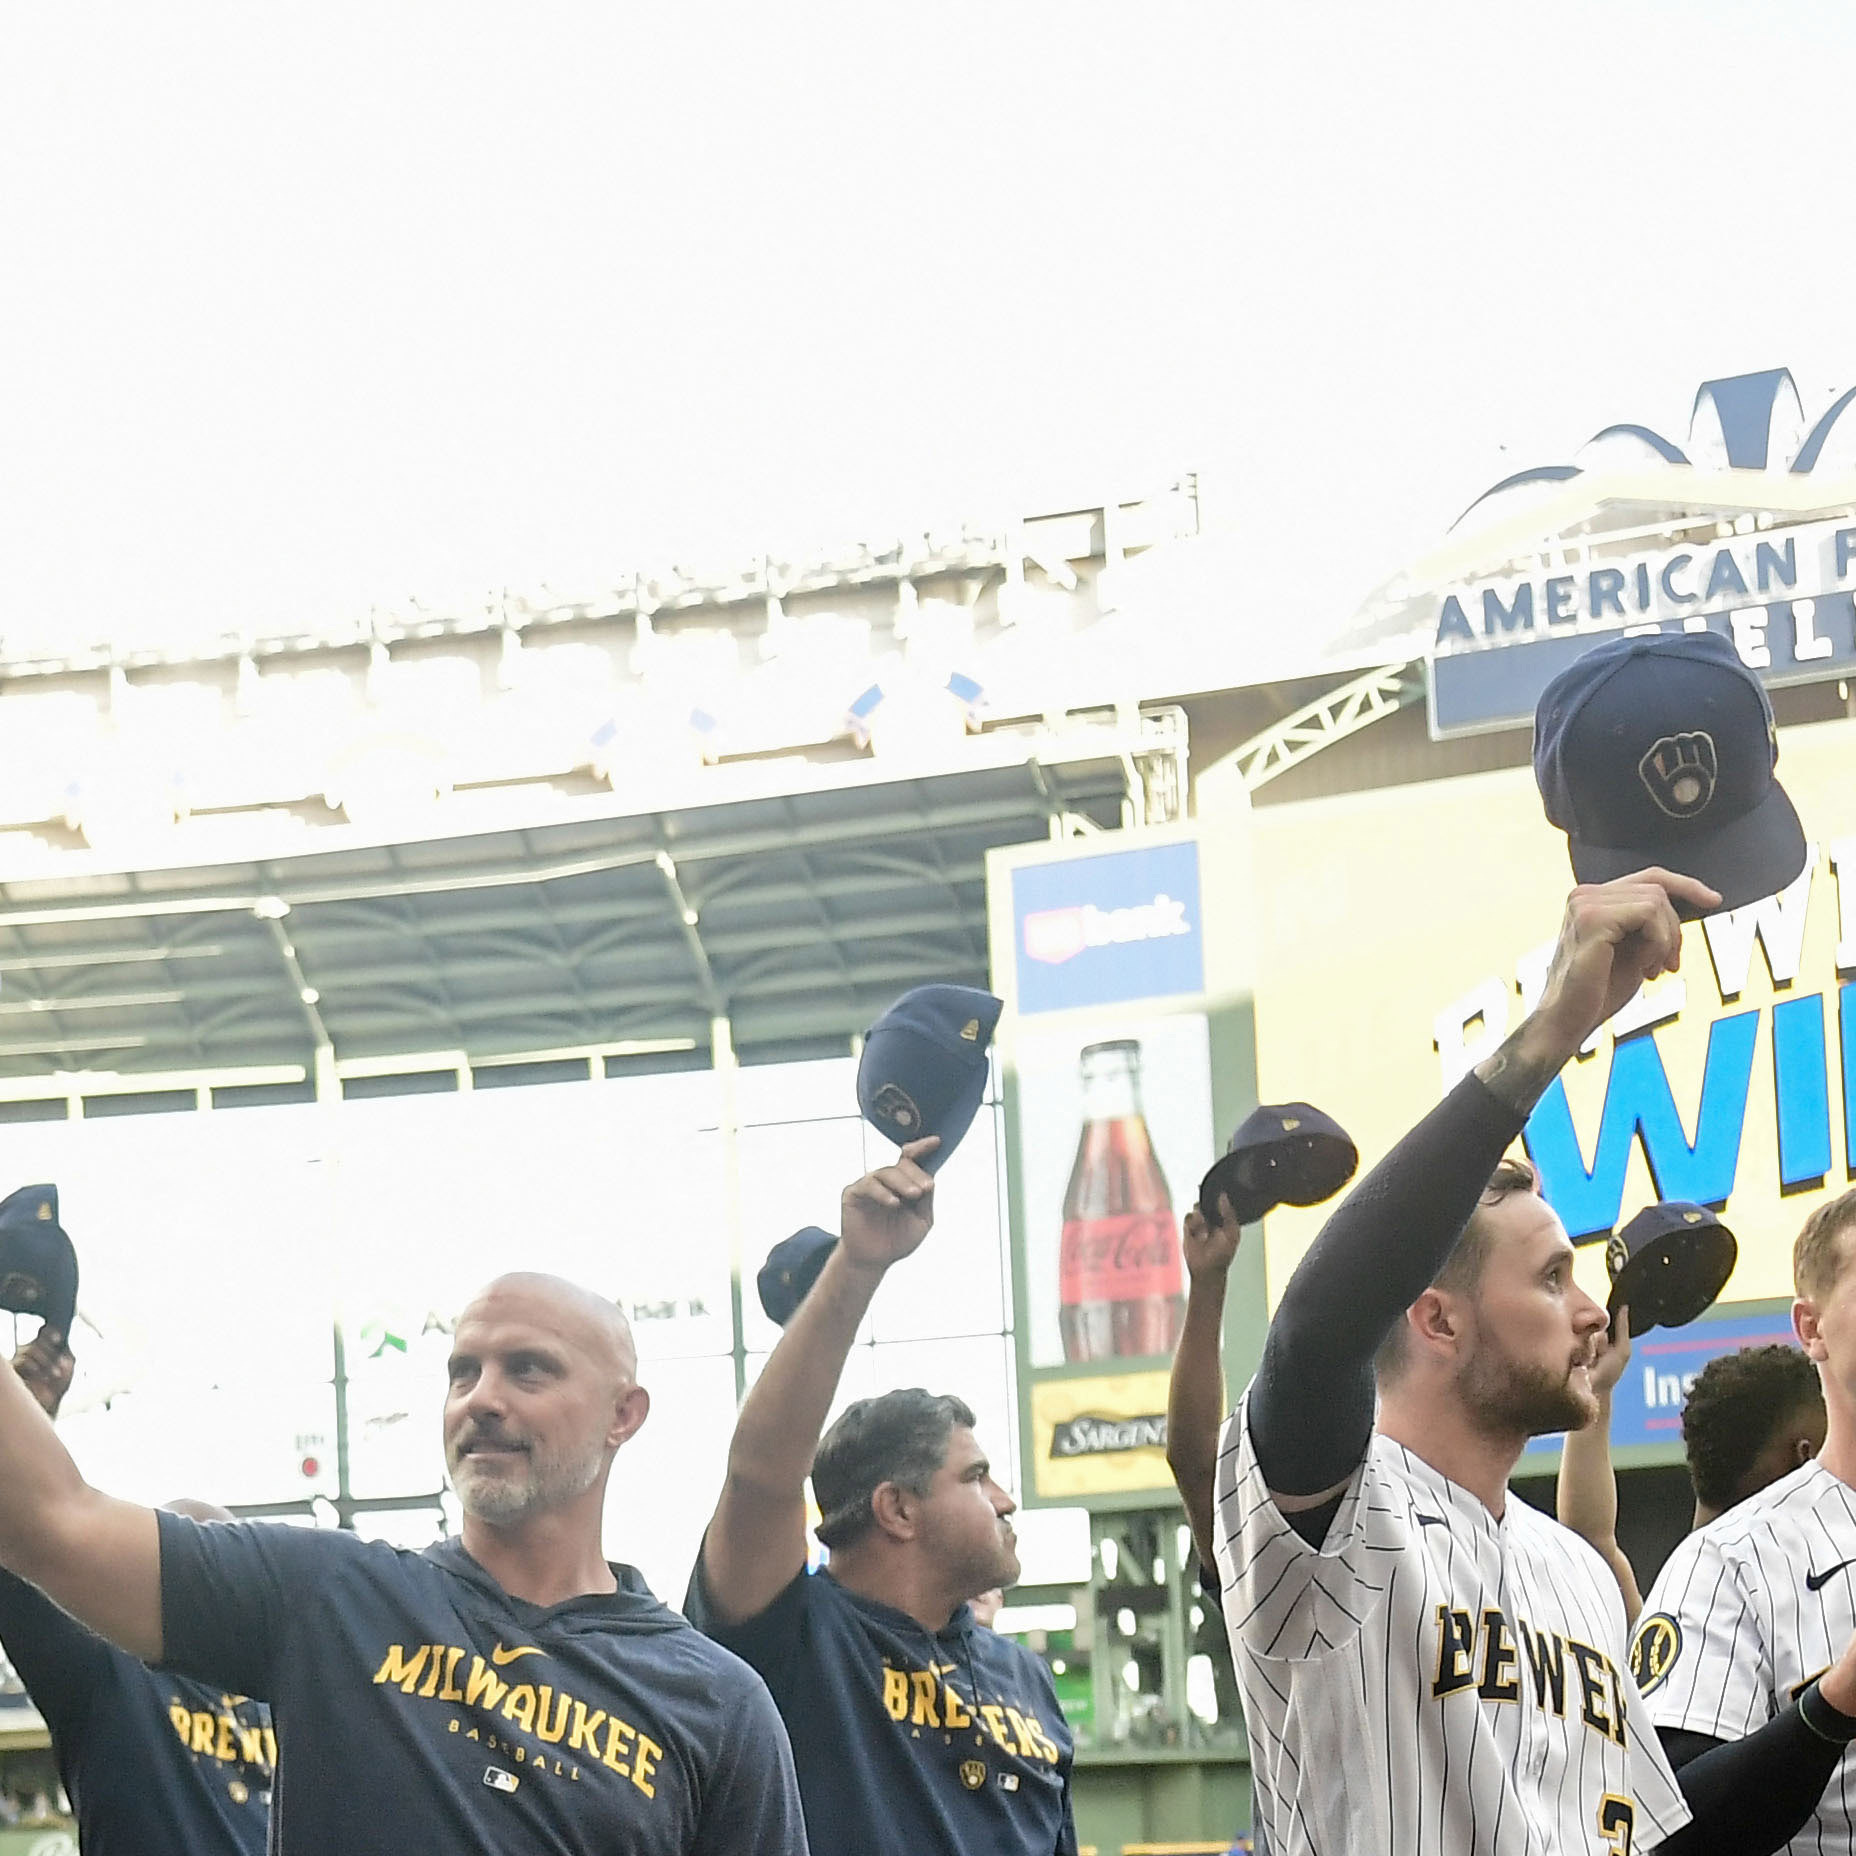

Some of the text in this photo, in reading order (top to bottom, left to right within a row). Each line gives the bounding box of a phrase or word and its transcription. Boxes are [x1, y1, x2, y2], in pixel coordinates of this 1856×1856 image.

[1435, 537, 1797, 648] AMERICAN
[372, 1644, 664, 1800] MILWAUKEE
[447, 1718, 581, 1782] BASEBALL
